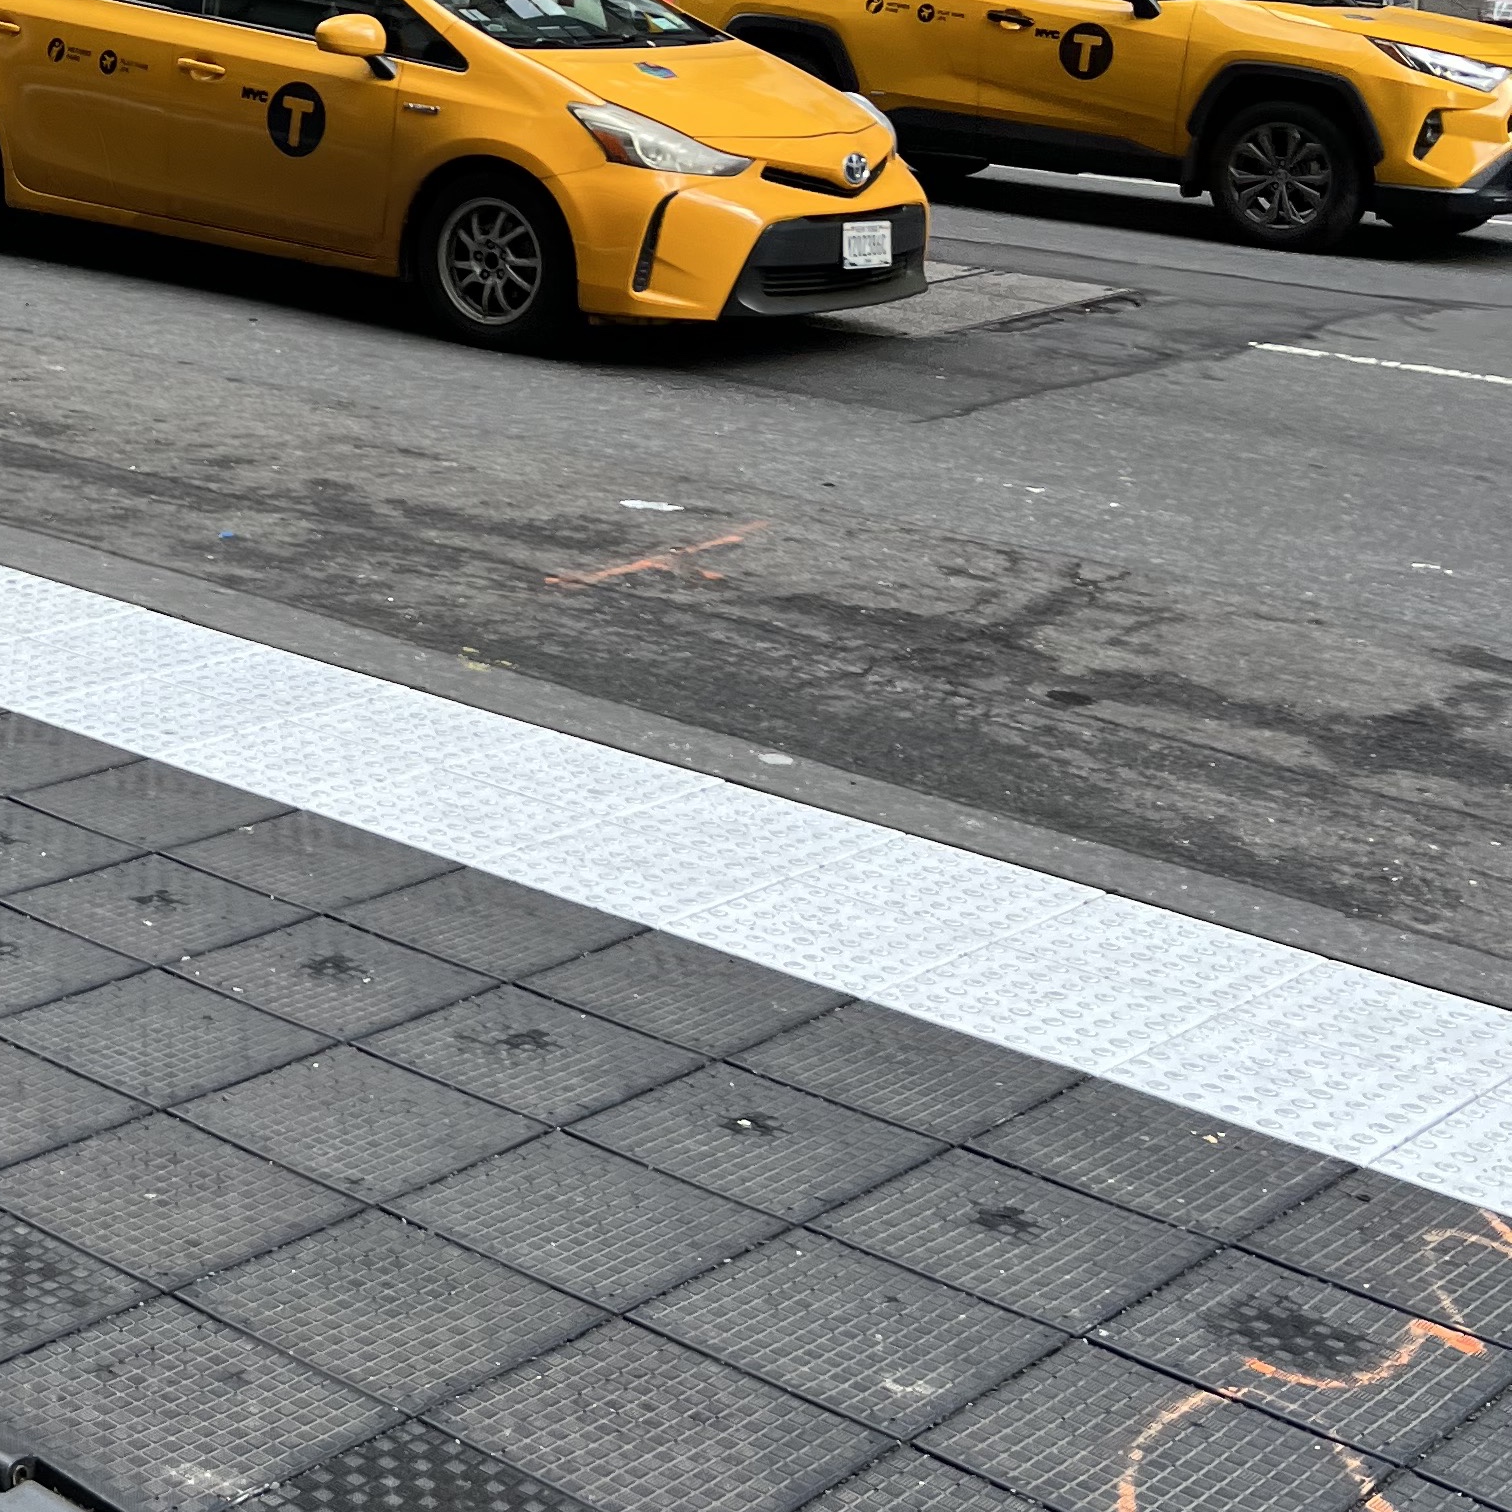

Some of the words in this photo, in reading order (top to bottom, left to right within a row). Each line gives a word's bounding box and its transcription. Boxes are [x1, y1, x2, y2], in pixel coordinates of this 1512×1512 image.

[1034, 27, 1061, 40] NYC
[1073, 33, 1103, 72] T
[241, 86, 268, 104] NYC
[282, 95, 315, 148] T
